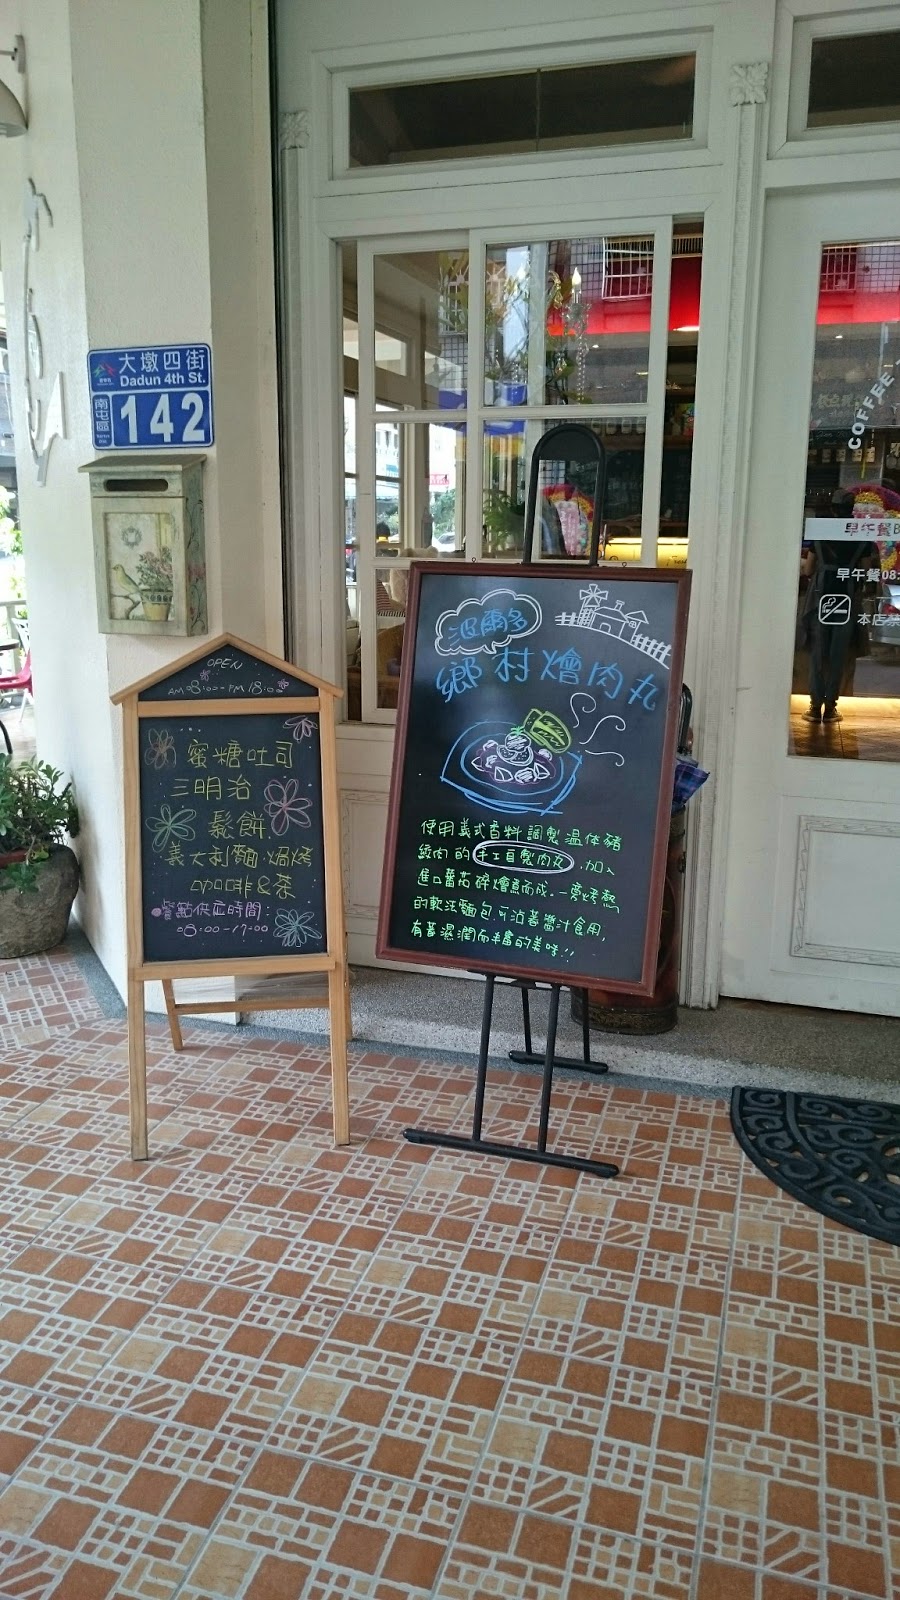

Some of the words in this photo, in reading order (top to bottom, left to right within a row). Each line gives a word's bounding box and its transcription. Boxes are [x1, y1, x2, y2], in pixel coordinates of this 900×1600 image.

[118, 349, 205, 374] 大墩四街
[120, 375, 161, 387] Dadun
[164, 373, 185, 385] 4th
[188, 371, 206, 384] St.
[94, 398, 110, 431] 南屯區
[120, 392, 205, 443] 142
[847, 372, 895, 450] COFFEE
[207, 659, 243, 670] OPEN
[187, 739, 293, 769] 蜜糖吐司
[171, 774, 251, 800] 三明治
[208, 810, 266, 839] 鬆餅
[190, 873, 295, 899] 咖啡&茶
